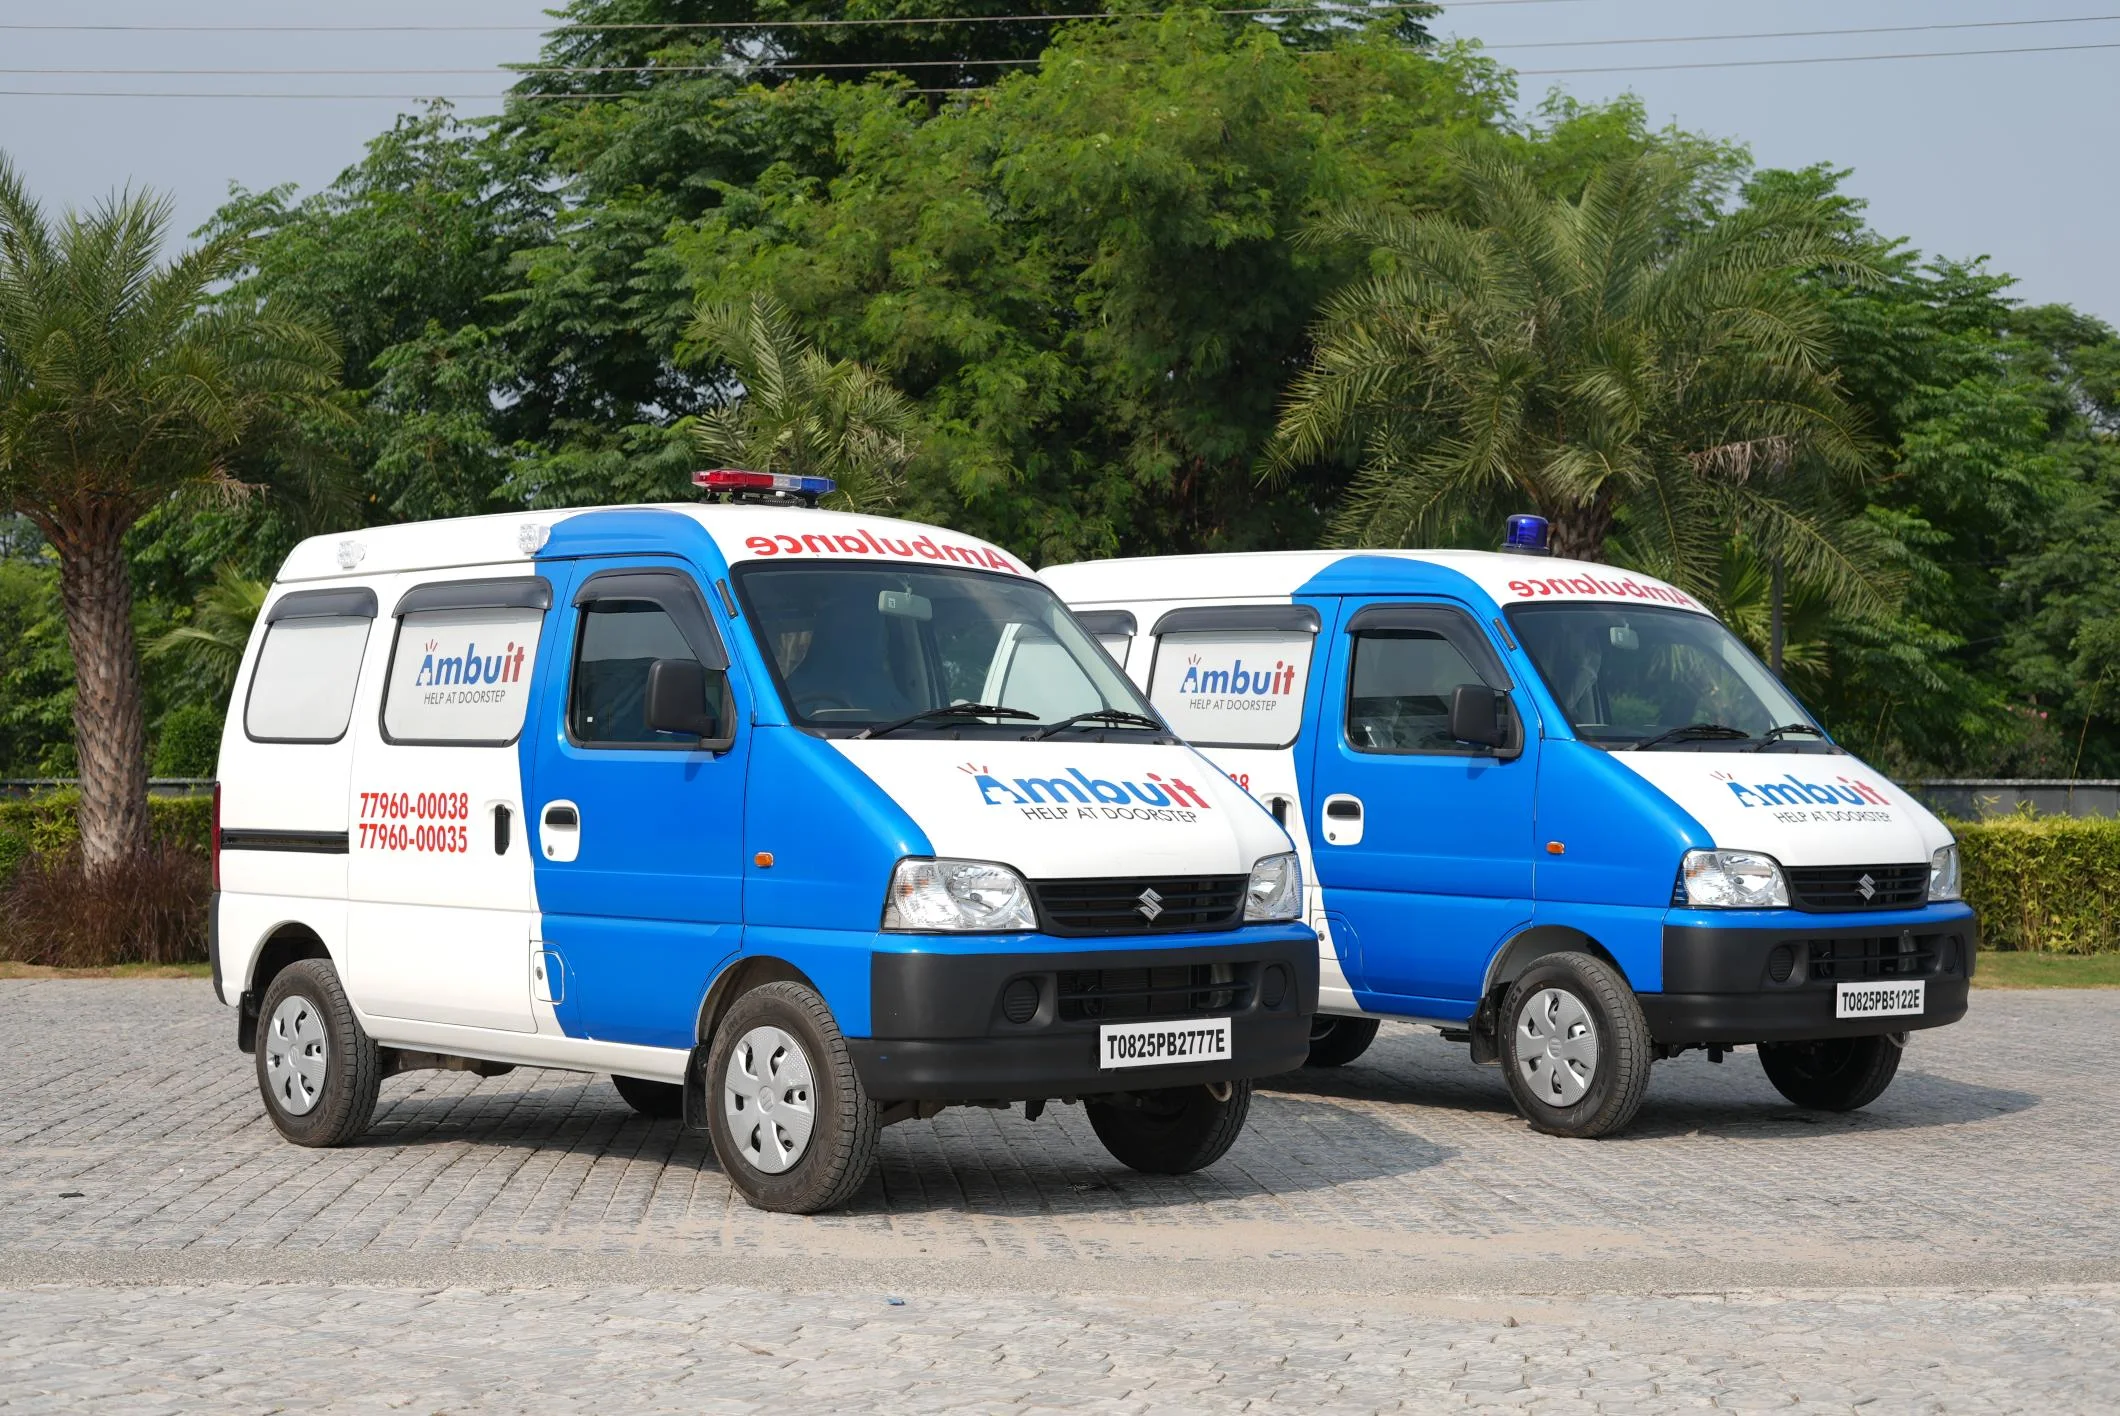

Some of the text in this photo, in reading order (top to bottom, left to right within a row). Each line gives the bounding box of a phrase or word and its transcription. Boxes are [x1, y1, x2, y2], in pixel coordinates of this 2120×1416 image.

[416, 641, 525, 686] Ambuit
[1179, 659, 1295, 695] Ambuit
[424, 690, 506, 705] HELP AT DOORSTEP
[1189, 699, 1277, 711] HELP AT DOORSTEP
[974, 767, 1211, 809] Ambuit
[1727, 774, 1891, 808] Ambuit
[360, 792, 468, 819] 77960-00038
[1021, 807, 1198, 823] HELP AT DOORSTEP
[1773, 811, 1893, 824] HELP AT DOORSTEP
[359, 823, 468, 853] 77960-00035
[1107, 1028, 1225, 1060] T0825PB2777E
